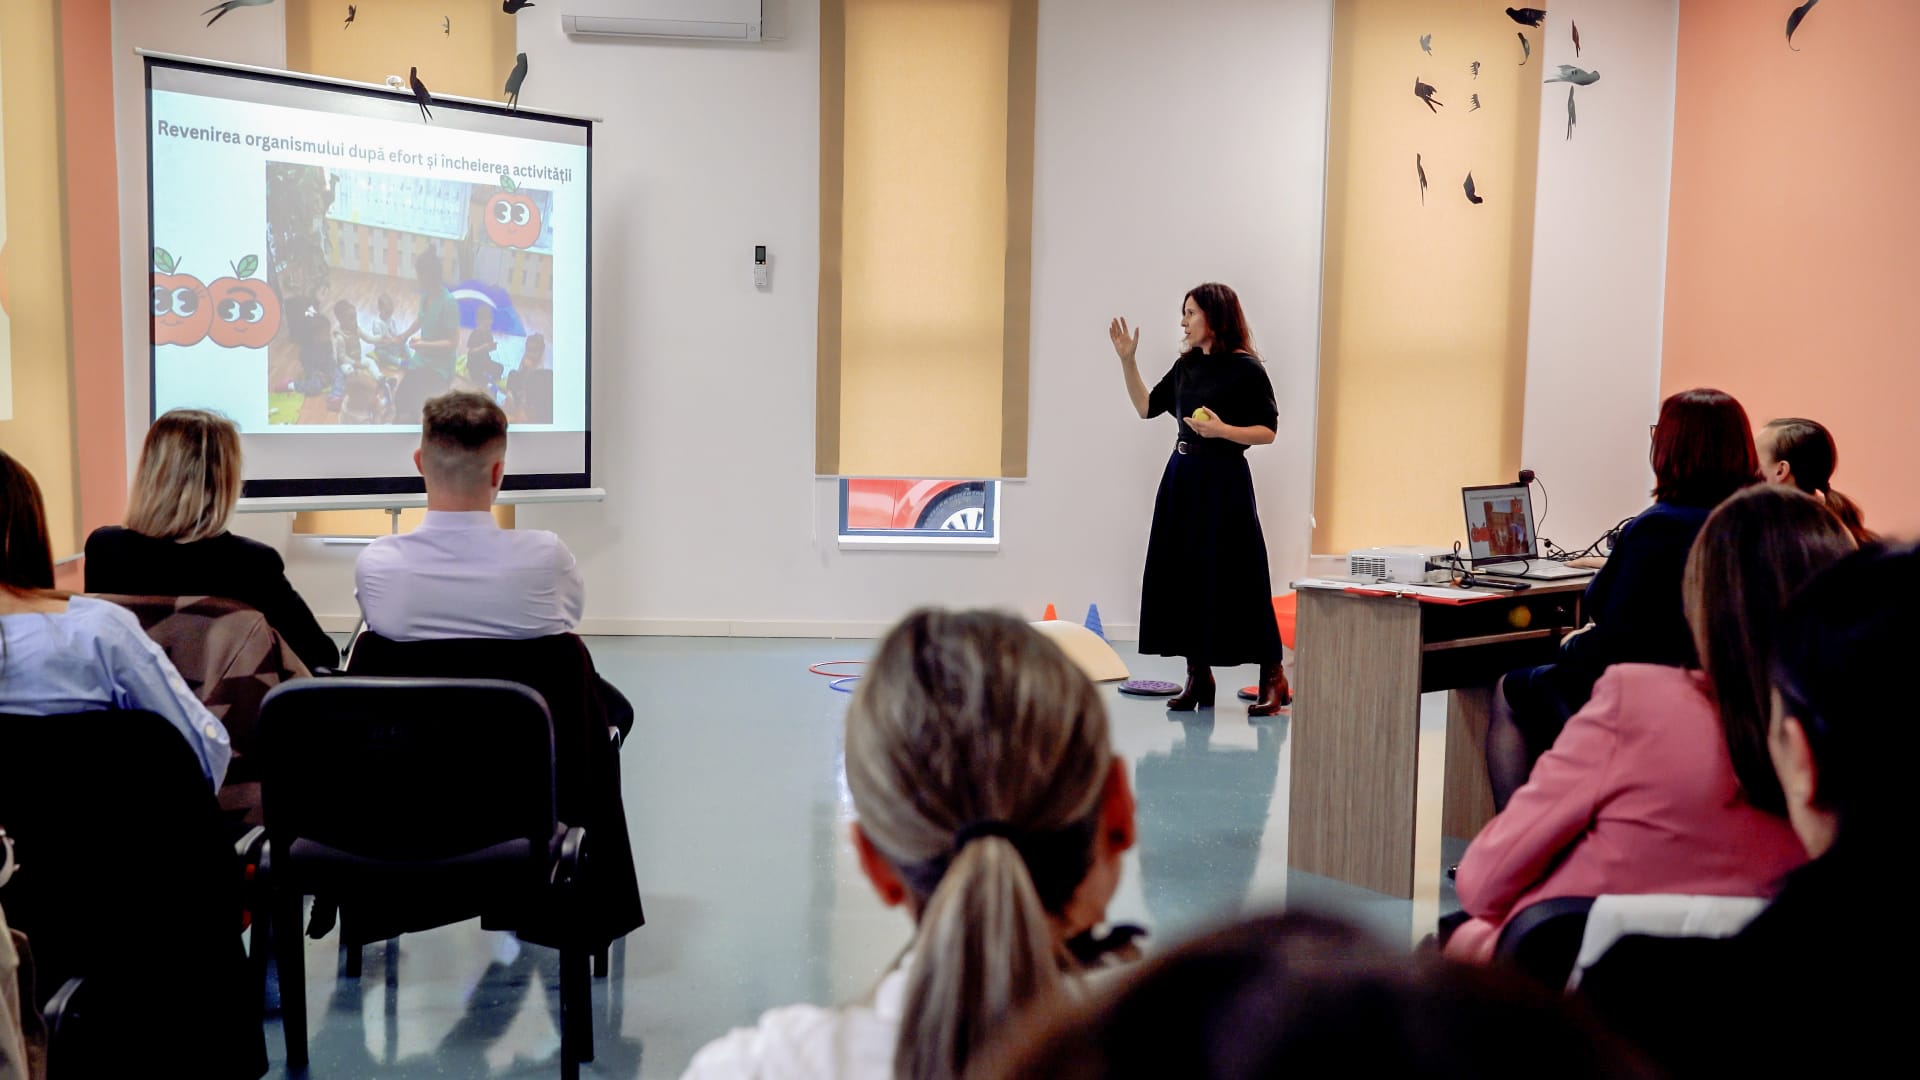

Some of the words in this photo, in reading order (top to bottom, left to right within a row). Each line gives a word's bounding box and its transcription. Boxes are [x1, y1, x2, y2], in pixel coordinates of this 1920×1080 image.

[158, 120, 241, 145] Revenirea
[245, 134, 345, 156] organismului
[348, 144, 385, 164] după
[389, 149, 424, 166] efort
[427, 153, 438, 170] și
[441, 153, 510, 175] încheierea
